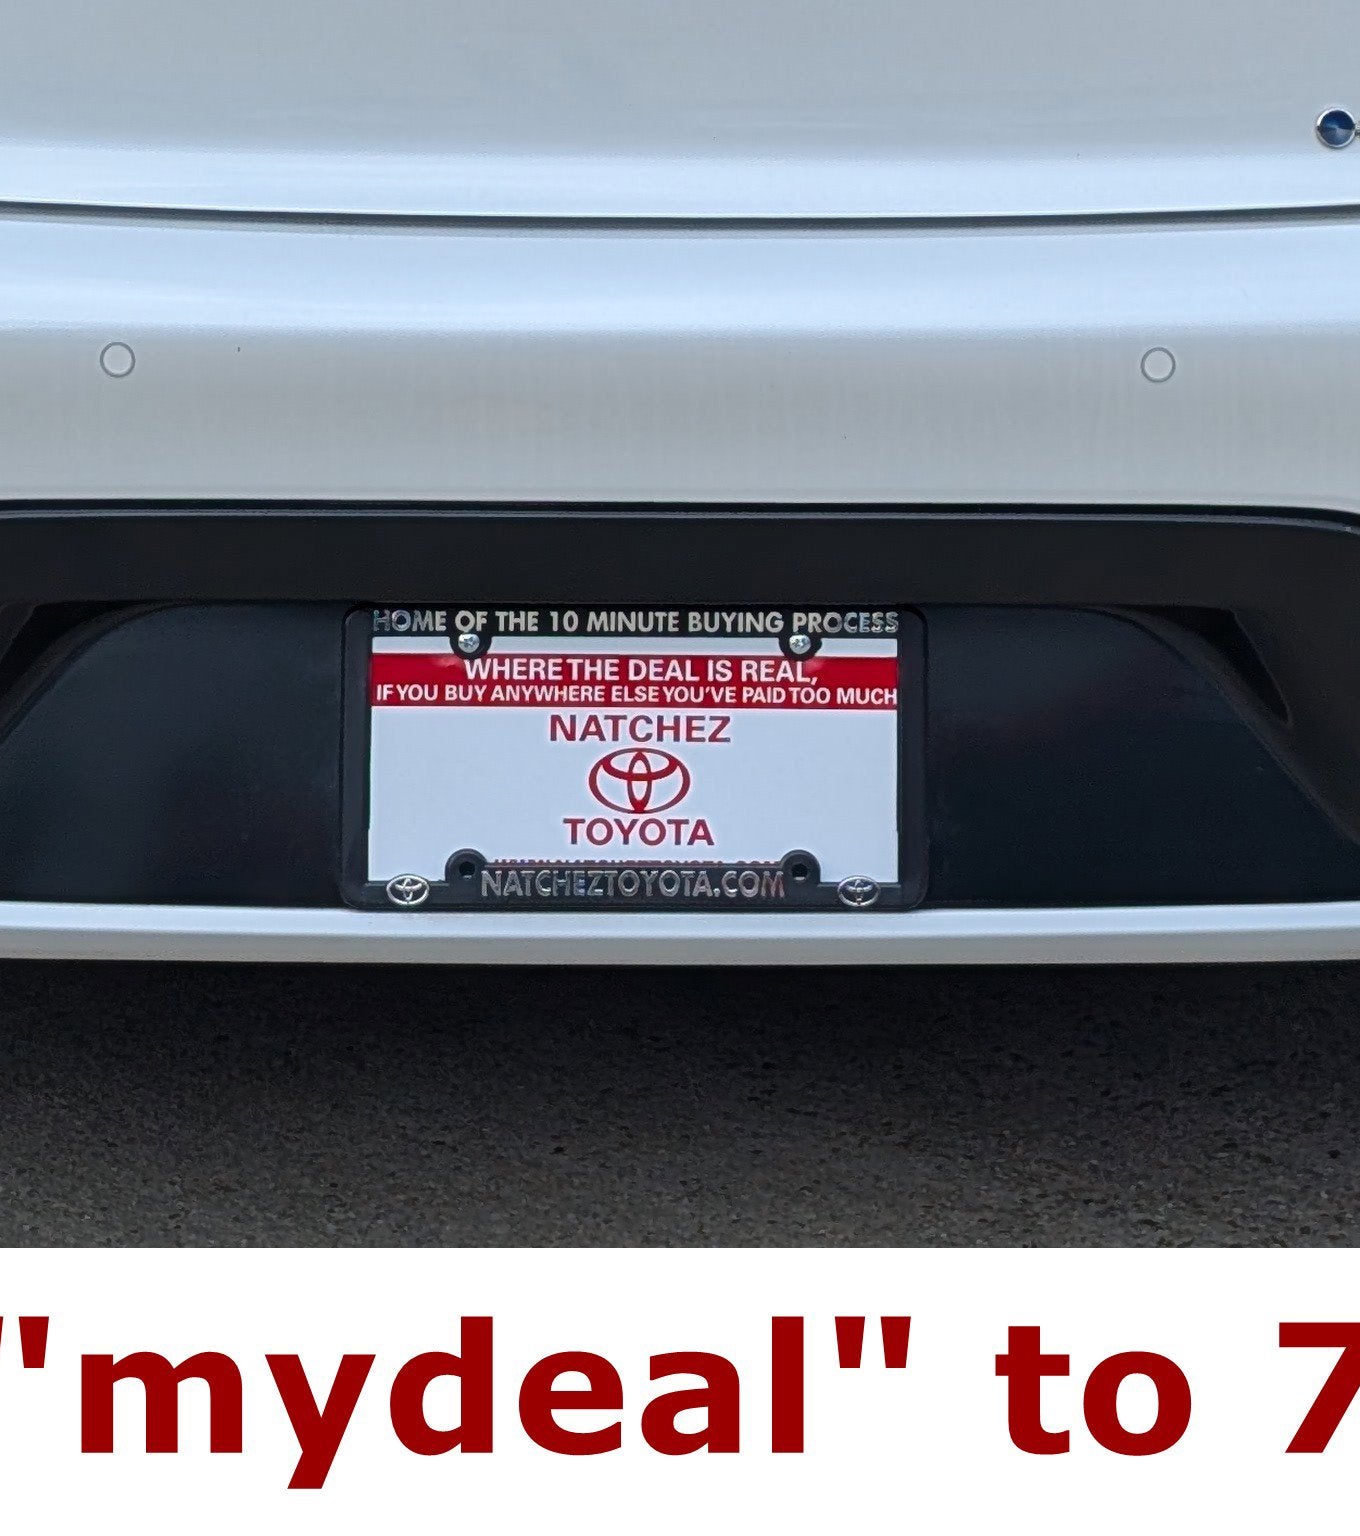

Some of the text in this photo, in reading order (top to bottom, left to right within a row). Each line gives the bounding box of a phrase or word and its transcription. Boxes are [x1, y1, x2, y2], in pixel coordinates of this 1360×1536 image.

[373, 610, 900, 634] HOME OF THE 10 MINUTE BUYING PROCESS
[464, 658, 819, 686] WHERE THE DEAL IS REAL,
[376, 684, 898, 706] IF YOU BUY ANYWHERE ELSE YOU'VE PAID TOO MUCH
[550, 715, 732, 742] NATCHEZ
[562, 818, 714, 846] TOYOTA
[480, 870, 786, 898] NATCHEZTOYOTA.COM
